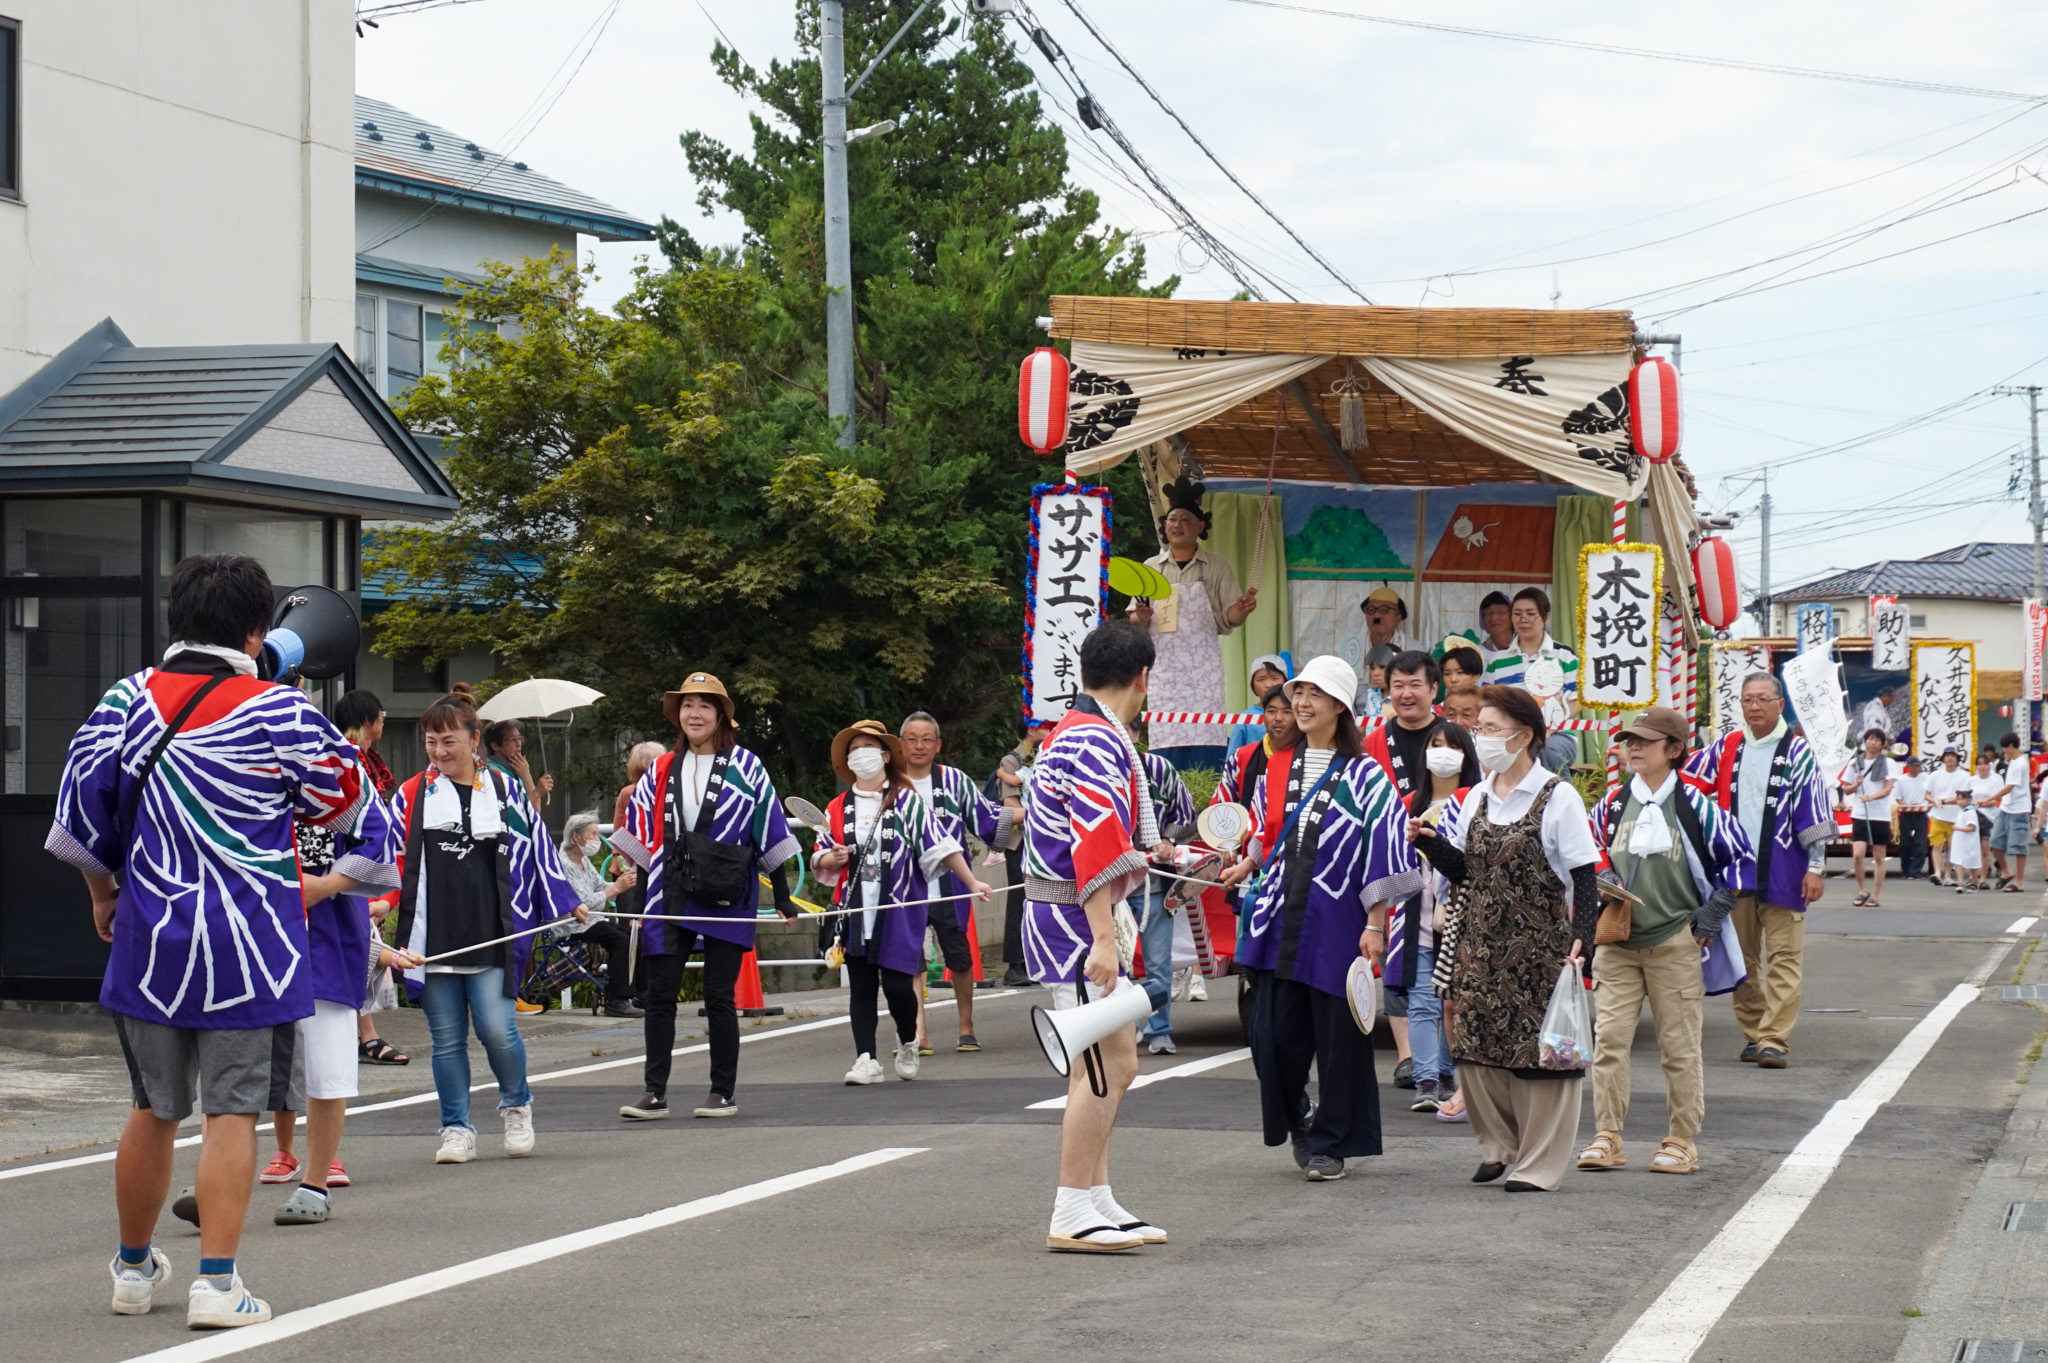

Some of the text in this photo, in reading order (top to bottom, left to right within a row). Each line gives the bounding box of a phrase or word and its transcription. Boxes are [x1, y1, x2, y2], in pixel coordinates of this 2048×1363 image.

[1590, 555, 1650, 698] 木挽町
[1877, 610, 1904, 666] 助さん
[1946, 648, 1969, 772] 久井名舘町内
[706, 756, 728, 802] 木挽町
[1765, 755, 1786, 808] 木挽町
[437, 841, 475, 860] today?
[881, 809, 894, 863] 木挽町
